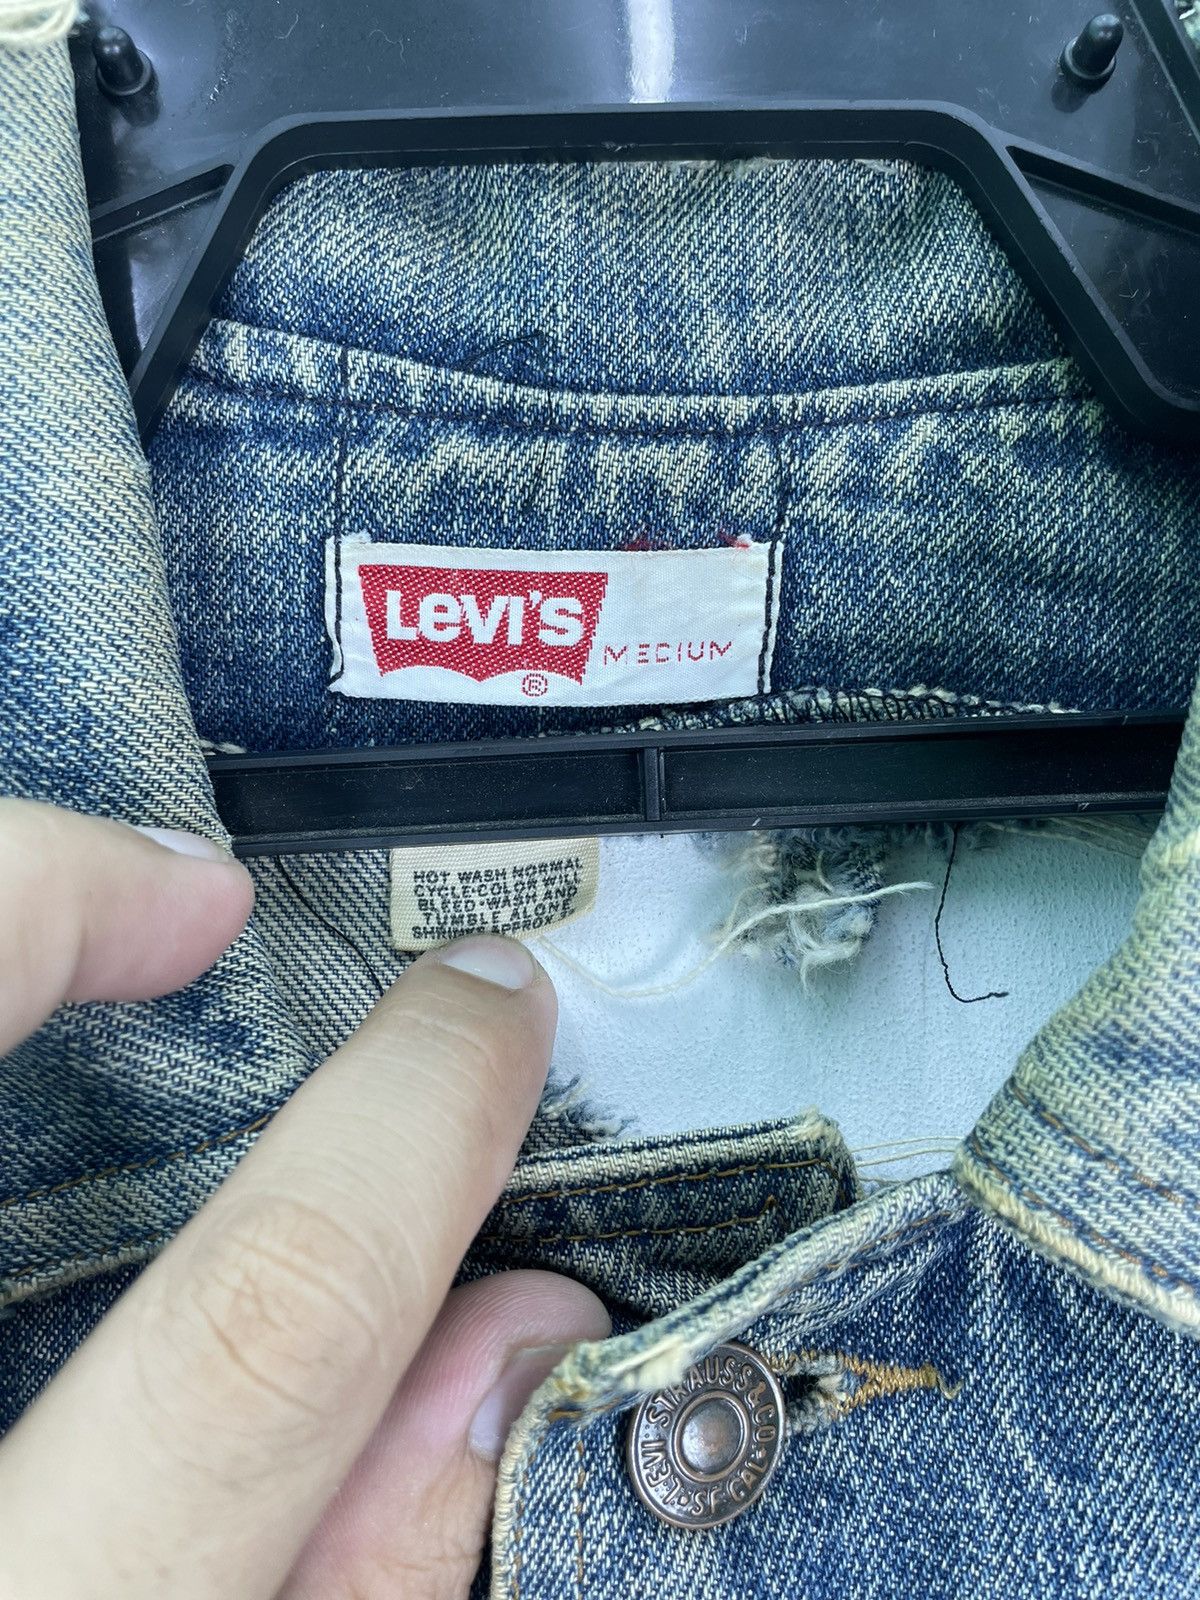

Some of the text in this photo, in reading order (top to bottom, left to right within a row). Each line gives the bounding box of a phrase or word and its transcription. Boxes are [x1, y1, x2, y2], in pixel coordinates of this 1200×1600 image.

[413, 857, 583, 884] HOT WASH NORMAL
[542, 871, 581, 888] WILL
[543, 884, 577, 901] AND
[423, 898, 572, 926] TUMBLE ALONE
[646, 1355, 753, 1428] STRAUSS
[642, 1440, 682, 1505] LEVI
